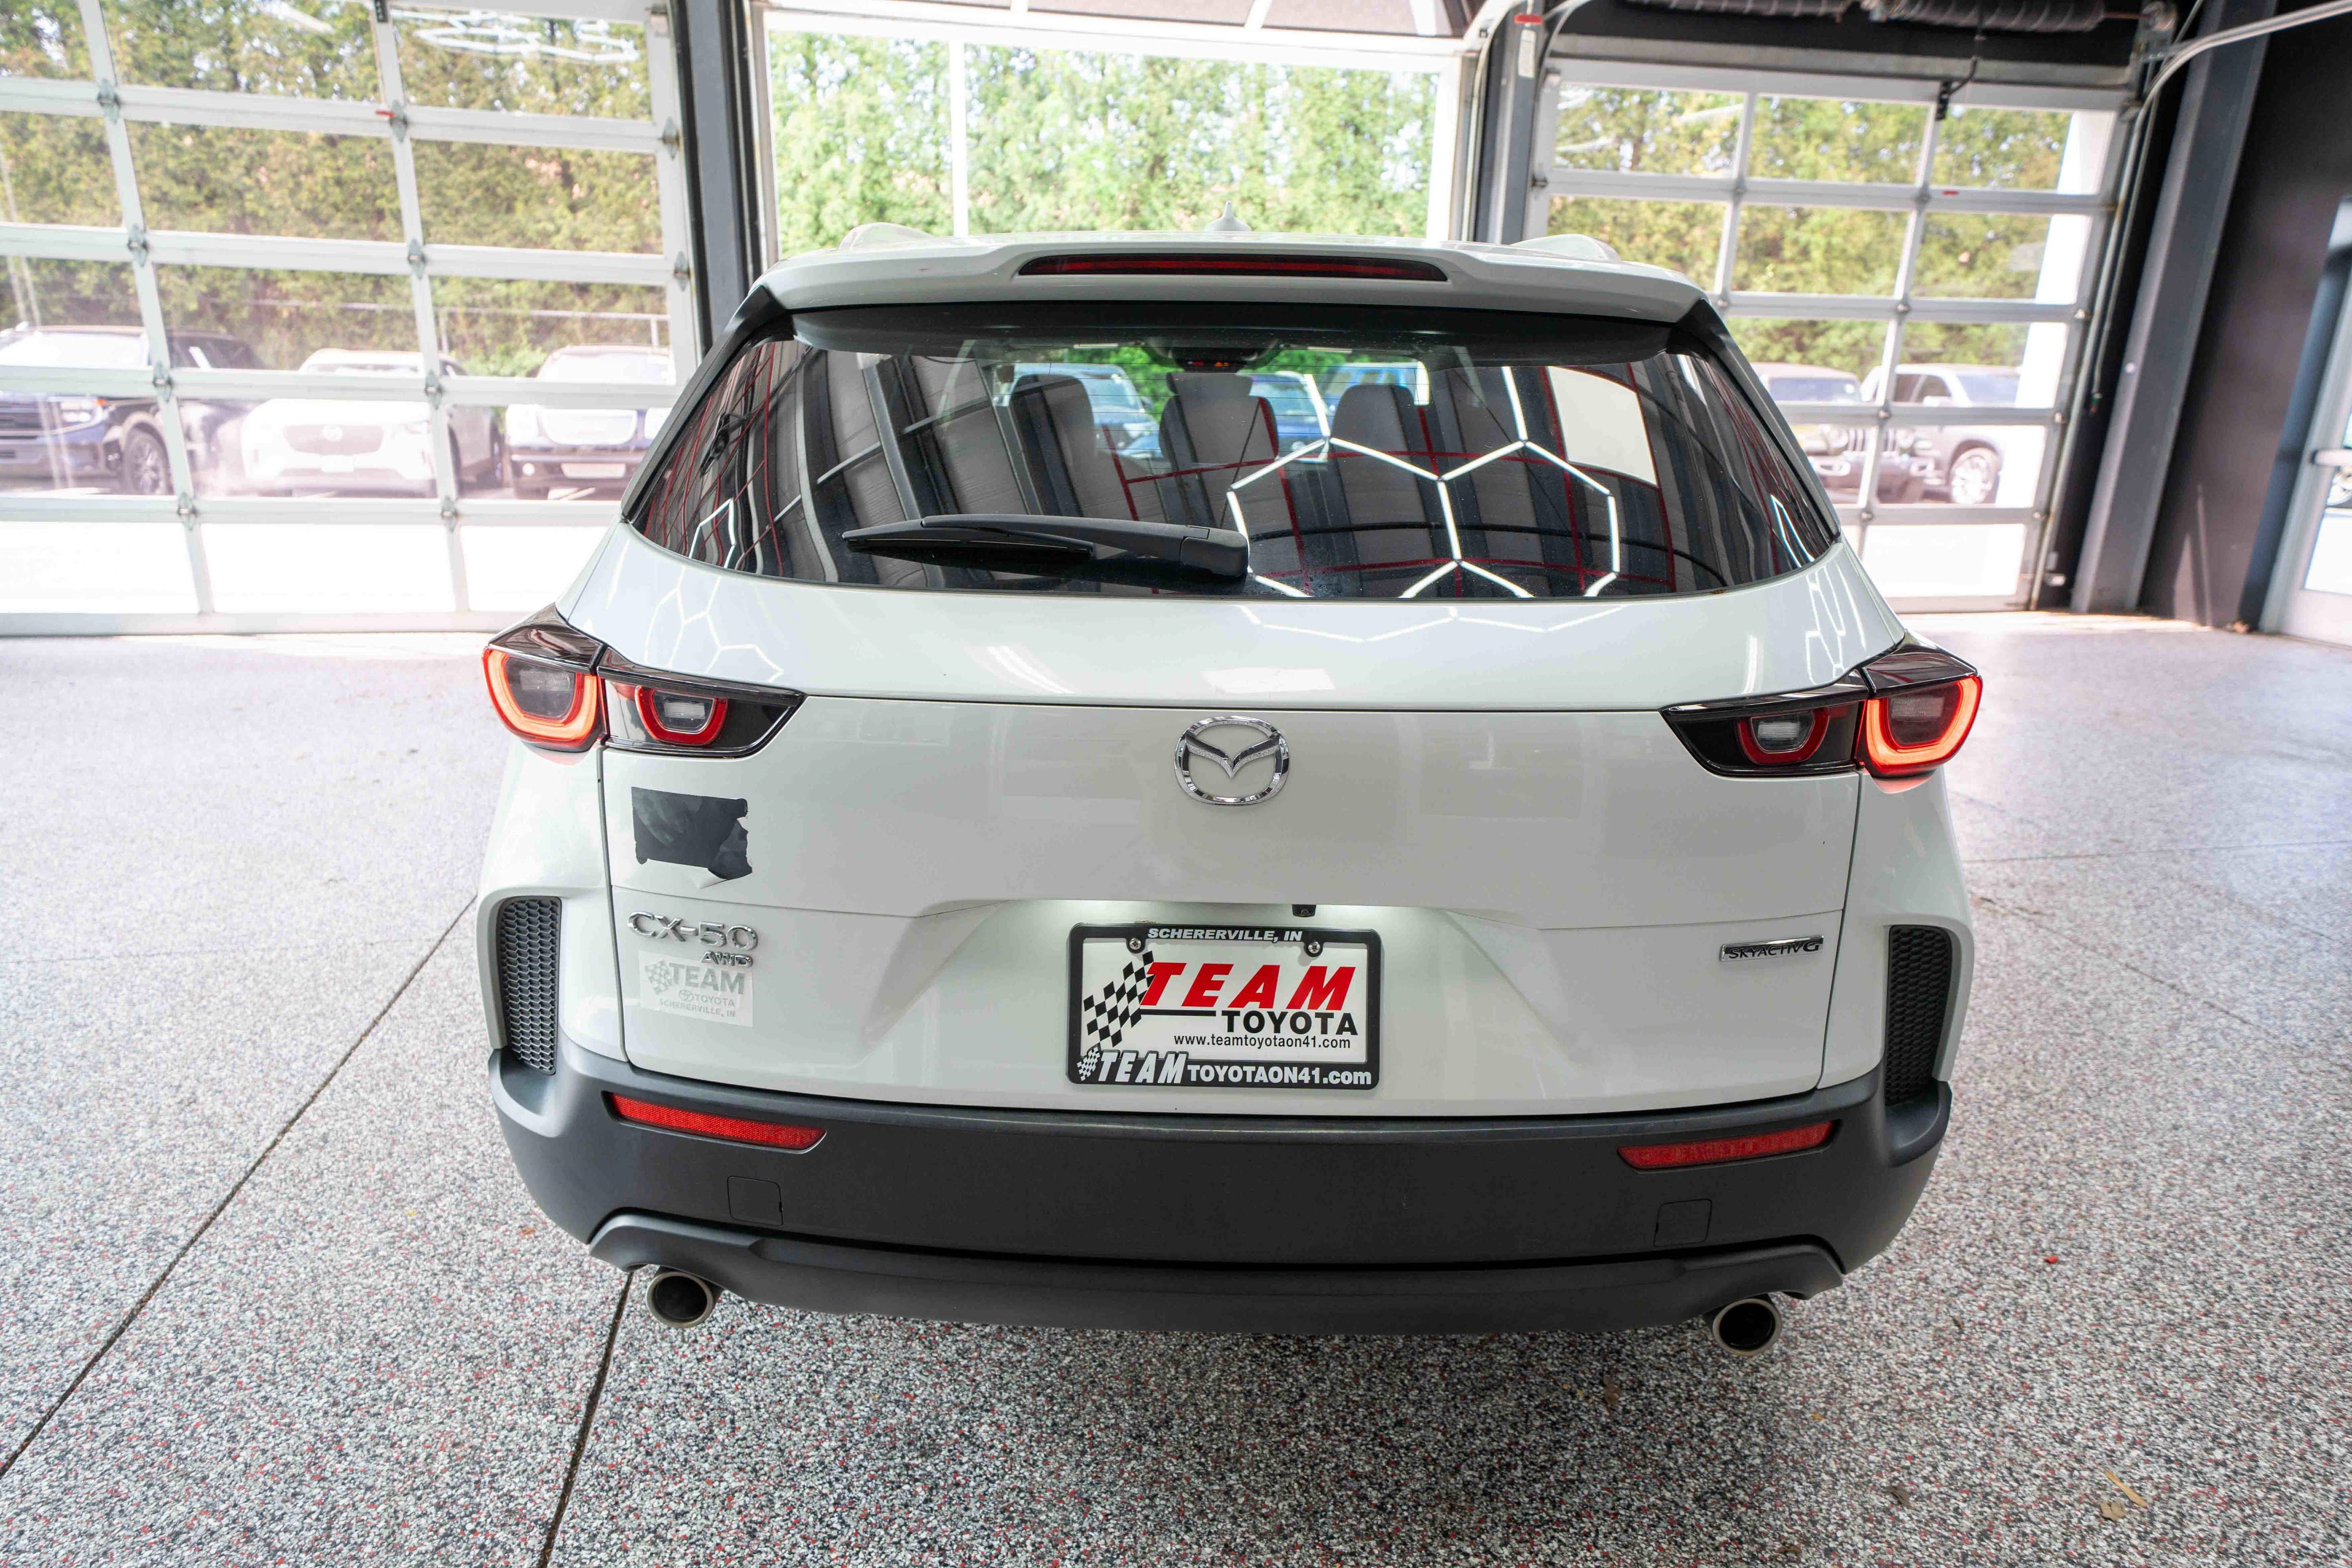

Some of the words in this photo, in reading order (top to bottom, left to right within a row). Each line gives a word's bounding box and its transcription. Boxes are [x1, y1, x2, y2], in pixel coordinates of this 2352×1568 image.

[627, 911, 758, 951] CX-50
[1147, 928, 1278, 943] SCHERERVILLE,
[1283, 931, 1303, 942] IN
[700, 951, 753, 967] AWD
[669, 962, 745, 995] TEAM
[1140, 962, 1356, 1011] TEAM
[659, 998, 724, 1017] SCHERERVILLE,
[694, 993, 735, 1007] TOYOTA
[1221, 1010, 1358, 1036] TOYOTA
[1174, 1033, 1350, 1049] www.teamtoyotaon41.com
